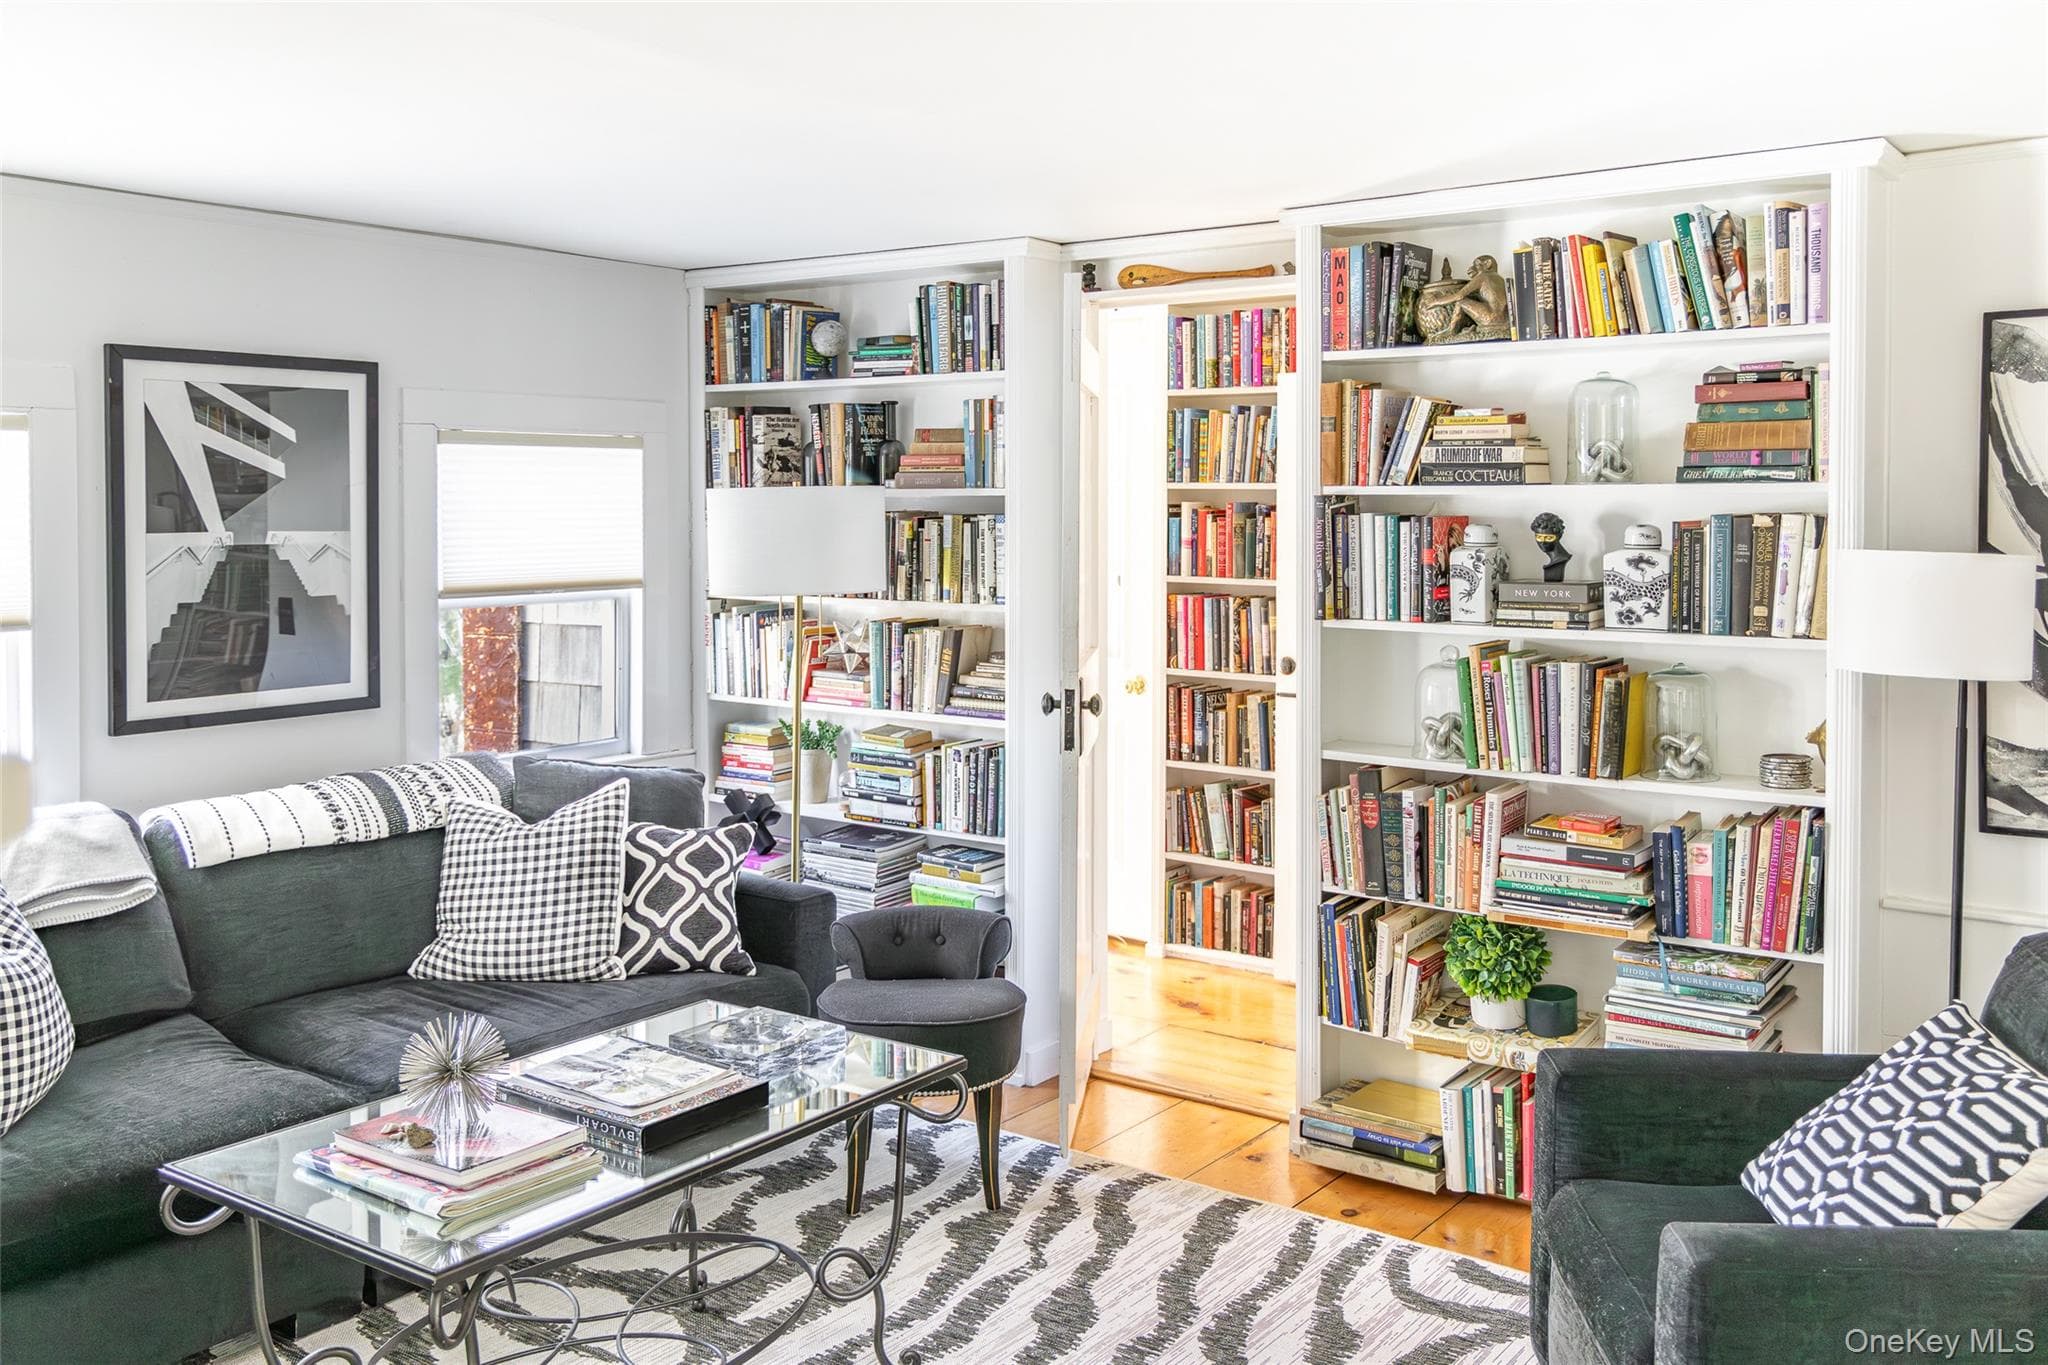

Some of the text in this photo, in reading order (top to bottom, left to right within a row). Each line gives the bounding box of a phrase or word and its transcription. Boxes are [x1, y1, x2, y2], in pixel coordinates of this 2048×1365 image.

[1811, 229, 1822, 273] THOUSAND
[1405, 255, 1427, 272] Beginning
[1335, 256, 1346, 305] MAO
[1536, 273, 1543, 283] OF
[1543, 261, 1554, 309] THE GATES
[1684, 237, 1709, 314] THE CONSCIOUS UNIVERSE
[937, 286, 949, 370] HUMANKIND FARB
[711, 429, 720, 449] TAKING
[713, 453, 721, 471] GETTY
[1434, 448, 1503, 462] A RUMOR OF WAR
[1455, 470, 1512, 482] COCTEAU
[1683, 470, 1757, 480] GREAT RELIGIONS
[1315, 517, 1324, 568] Joan Rivers
[1715, 534, 1723, 562] LUDWIG
[1764, 532, 1774, 562] SAMUEL
[1716, 562, 1724, 612] WITTGENSTEIN
[1754, 565, 1764, 601] John Wain
[1514, 590, 1571, 598] NEW YORK
[1483, 677, 1497, 750] Roses Dummies
[1474, 805, 1482, 823] ISAAC
[1473, 824, 1482, 843] HAYES
[1527, 828, 1543, 836] PEARL
[1552, 831, 1566, 839] BUCK
[1773, 821, 1783, 836] FLEA
[1472, 852, 1480, 871] Cooking
[1770, 839, 1782, 866] MARKET
[1782, 834, 1797, 880] SUPER TUSCAN
[1504, 869, 1573, 883] LA TECHNIQUE
[1769, 867, 1778, 887] STYLE
[1512, 883, 1561, 894] INDOOR PLANTS
[1471, 894, 1479, 905] Soul
[1694, 880, 1703, 935] Impressionism
[1736, 898, 1744, 923] Gourmet
[1622, 967, 1759, 993] HIDDEN REVEALED
[1626, 1037, 1650, 1045] COMPLETE
[577, 1115, 636, 1141] BVLGARI
[1367, 1132, 1382, 1142] Orsay
[1505, 1122, 1513, 1146] MAN'S
[1390, 1138, 1402, 1147] visit
[1402, 1141, 1415, 1149] your
[1505, 1147, 1513, 1176] GARDEN
